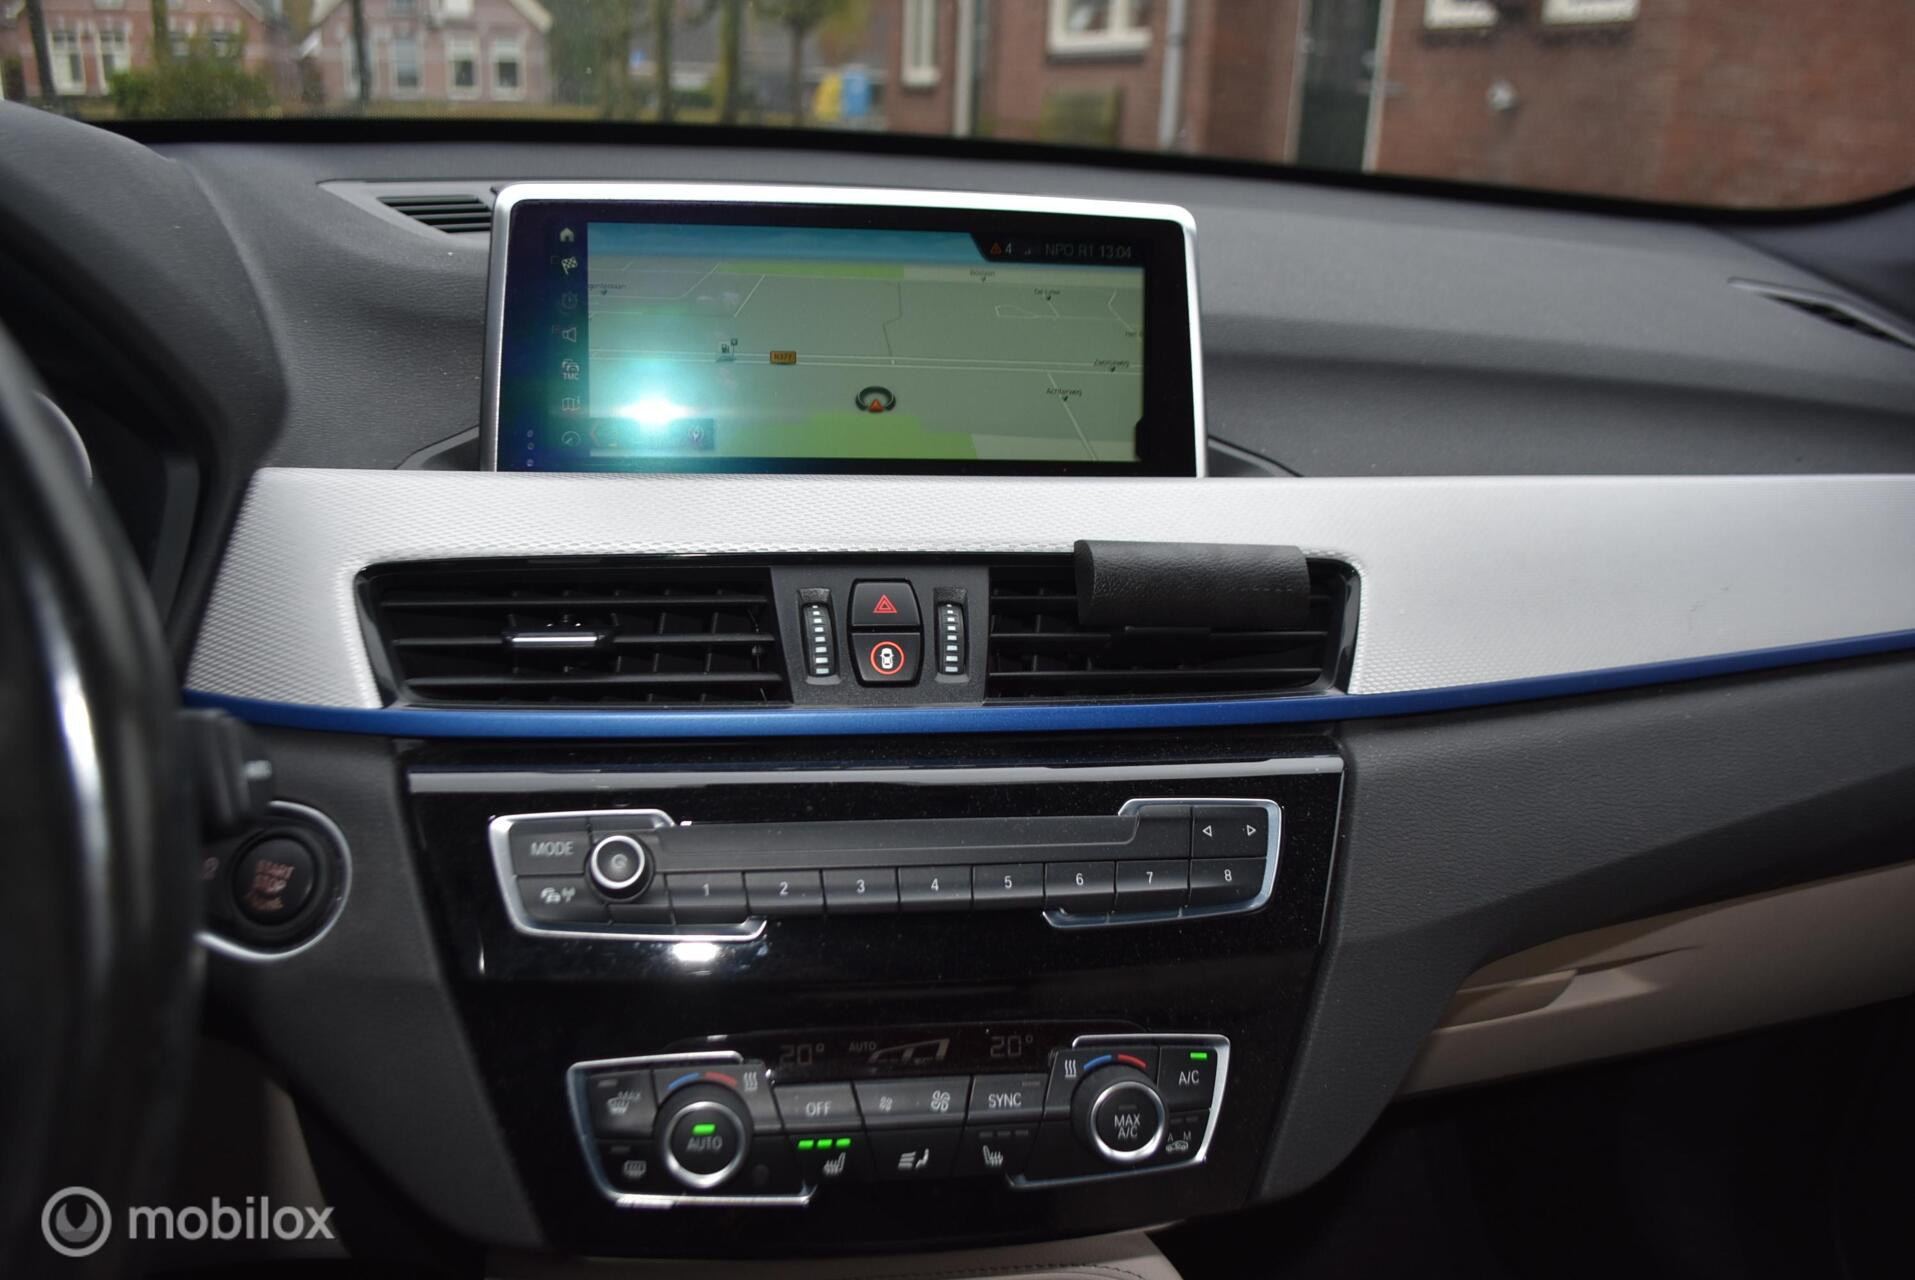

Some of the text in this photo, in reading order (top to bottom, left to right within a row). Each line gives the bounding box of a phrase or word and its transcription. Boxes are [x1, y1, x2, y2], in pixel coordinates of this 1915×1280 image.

[1004, 242, 1013, 255] 4
[1045, 242, 1132, 259] NPO R1 13:04
[530, 841, 574, 857] MODE
[1075, 873, 1084, 886] 6
[1146, 871, 1154, 884] 7
[1224, 868, 1233, 882] 8
[702, 883, 710, 896] 1
[779, 881, 789, 896] 2
[856, 879, 865, 893] 3
[930, 878, 939, 891] 4
[1004, 876, 1013, 889] 5
[848, 1040, 877, 1052] AUTO
[1178, 1069, 1200, 1086] A/C
[988, 1092, 1022, 1109] SYNC
[806, 1101, 832, 1118] OFF
[1114, 1113, 1140, 1128] MAX
[1117, 1126, 1138, 1140] A/C
[1167, 1130, 1192, 1142] A M
[687, 1135, 723, 1152] AUTO
